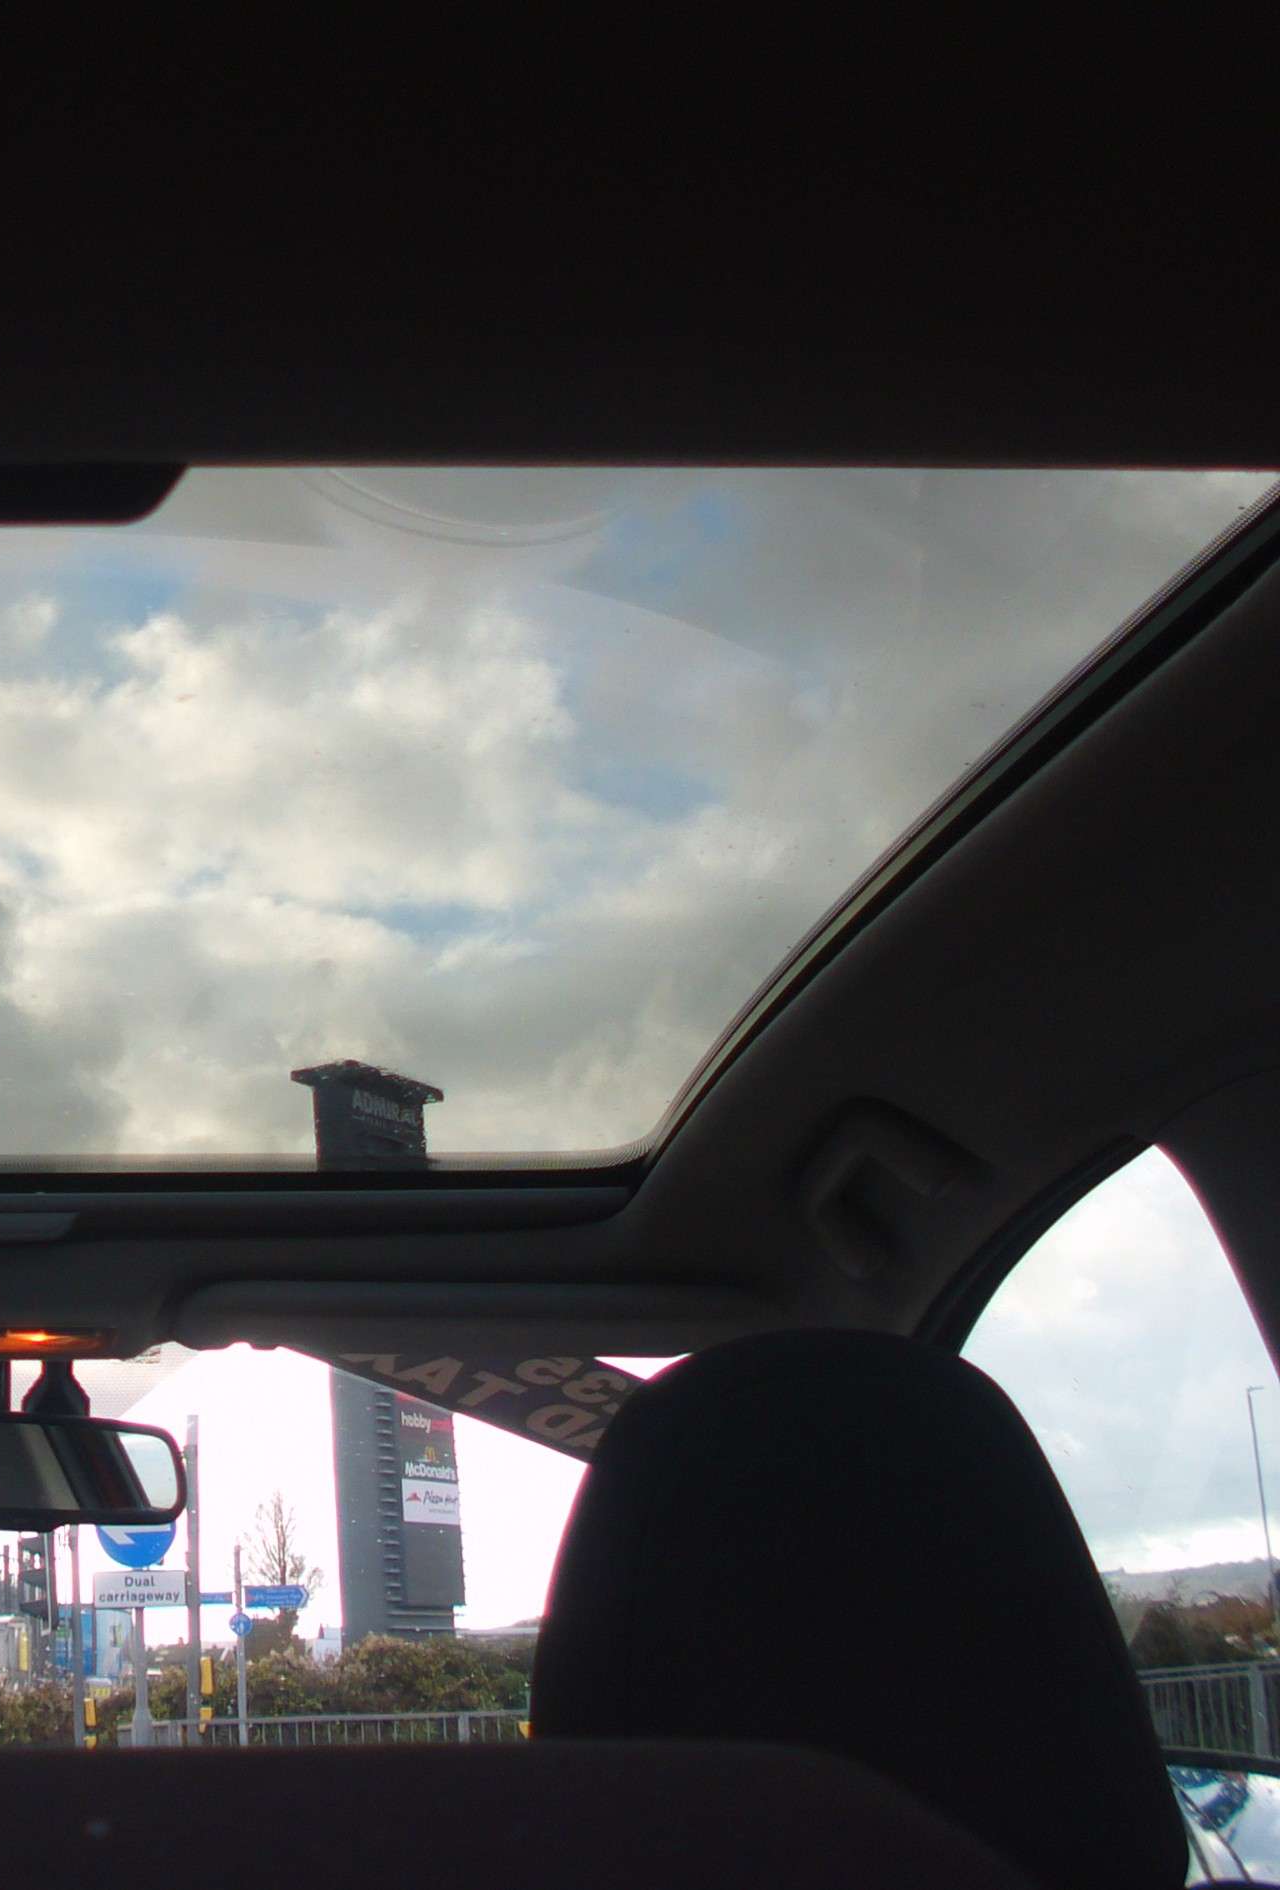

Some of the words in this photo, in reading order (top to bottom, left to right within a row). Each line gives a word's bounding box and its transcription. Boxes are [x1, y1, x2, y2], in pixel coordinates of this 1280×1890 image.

[404, 1460, 456, 1481] McDonald's
[125, 1575, 155, 1588] Dual
[98, 1590, 180, 1604] carriageway
